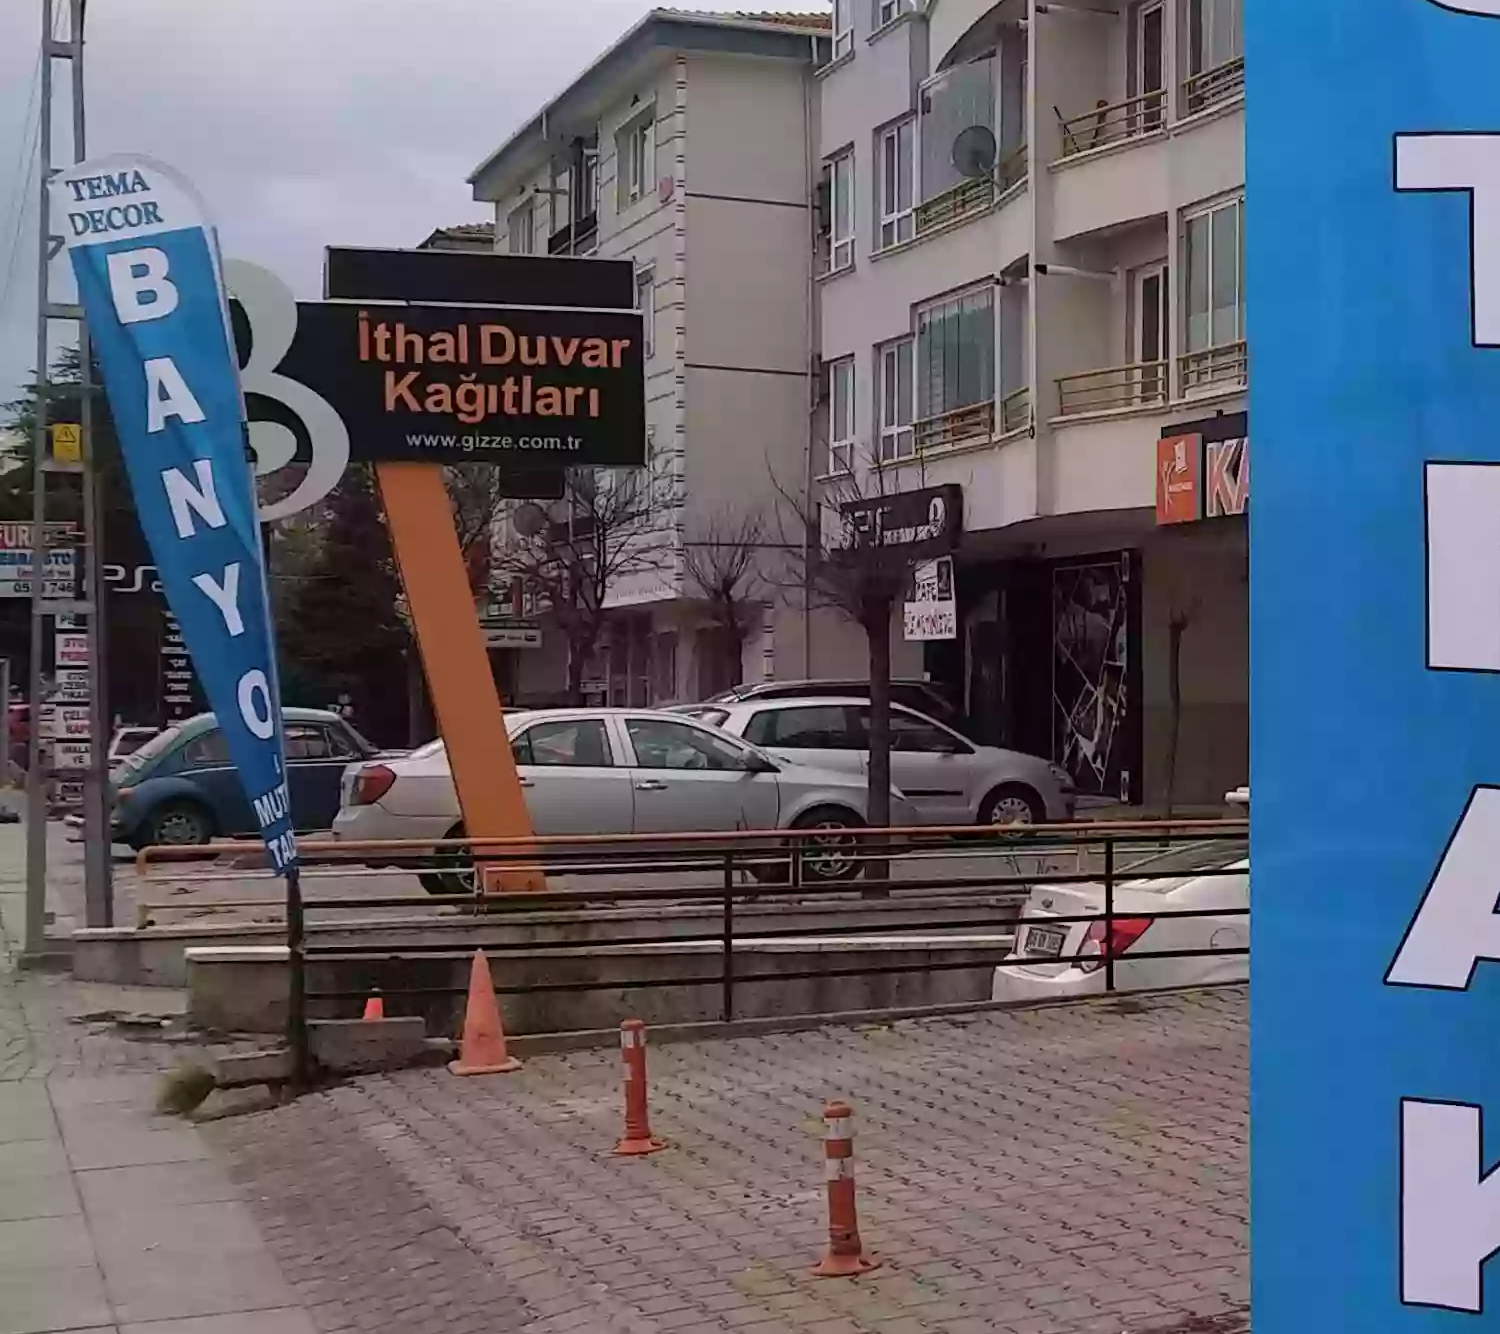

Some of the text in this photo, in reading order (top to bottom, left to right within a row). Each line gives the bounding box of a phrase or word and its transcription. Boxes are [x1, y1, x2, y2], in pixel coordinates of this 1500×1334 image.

[65, 169, 151, 203] TEMA
[67, 200, 164, 237] DECOR
[357, 310, 632, 369] İthal Duvar
[383, 370, 601, 425] Kağıtları
[405, 429, 583, 451] www.gizze.com.tr
